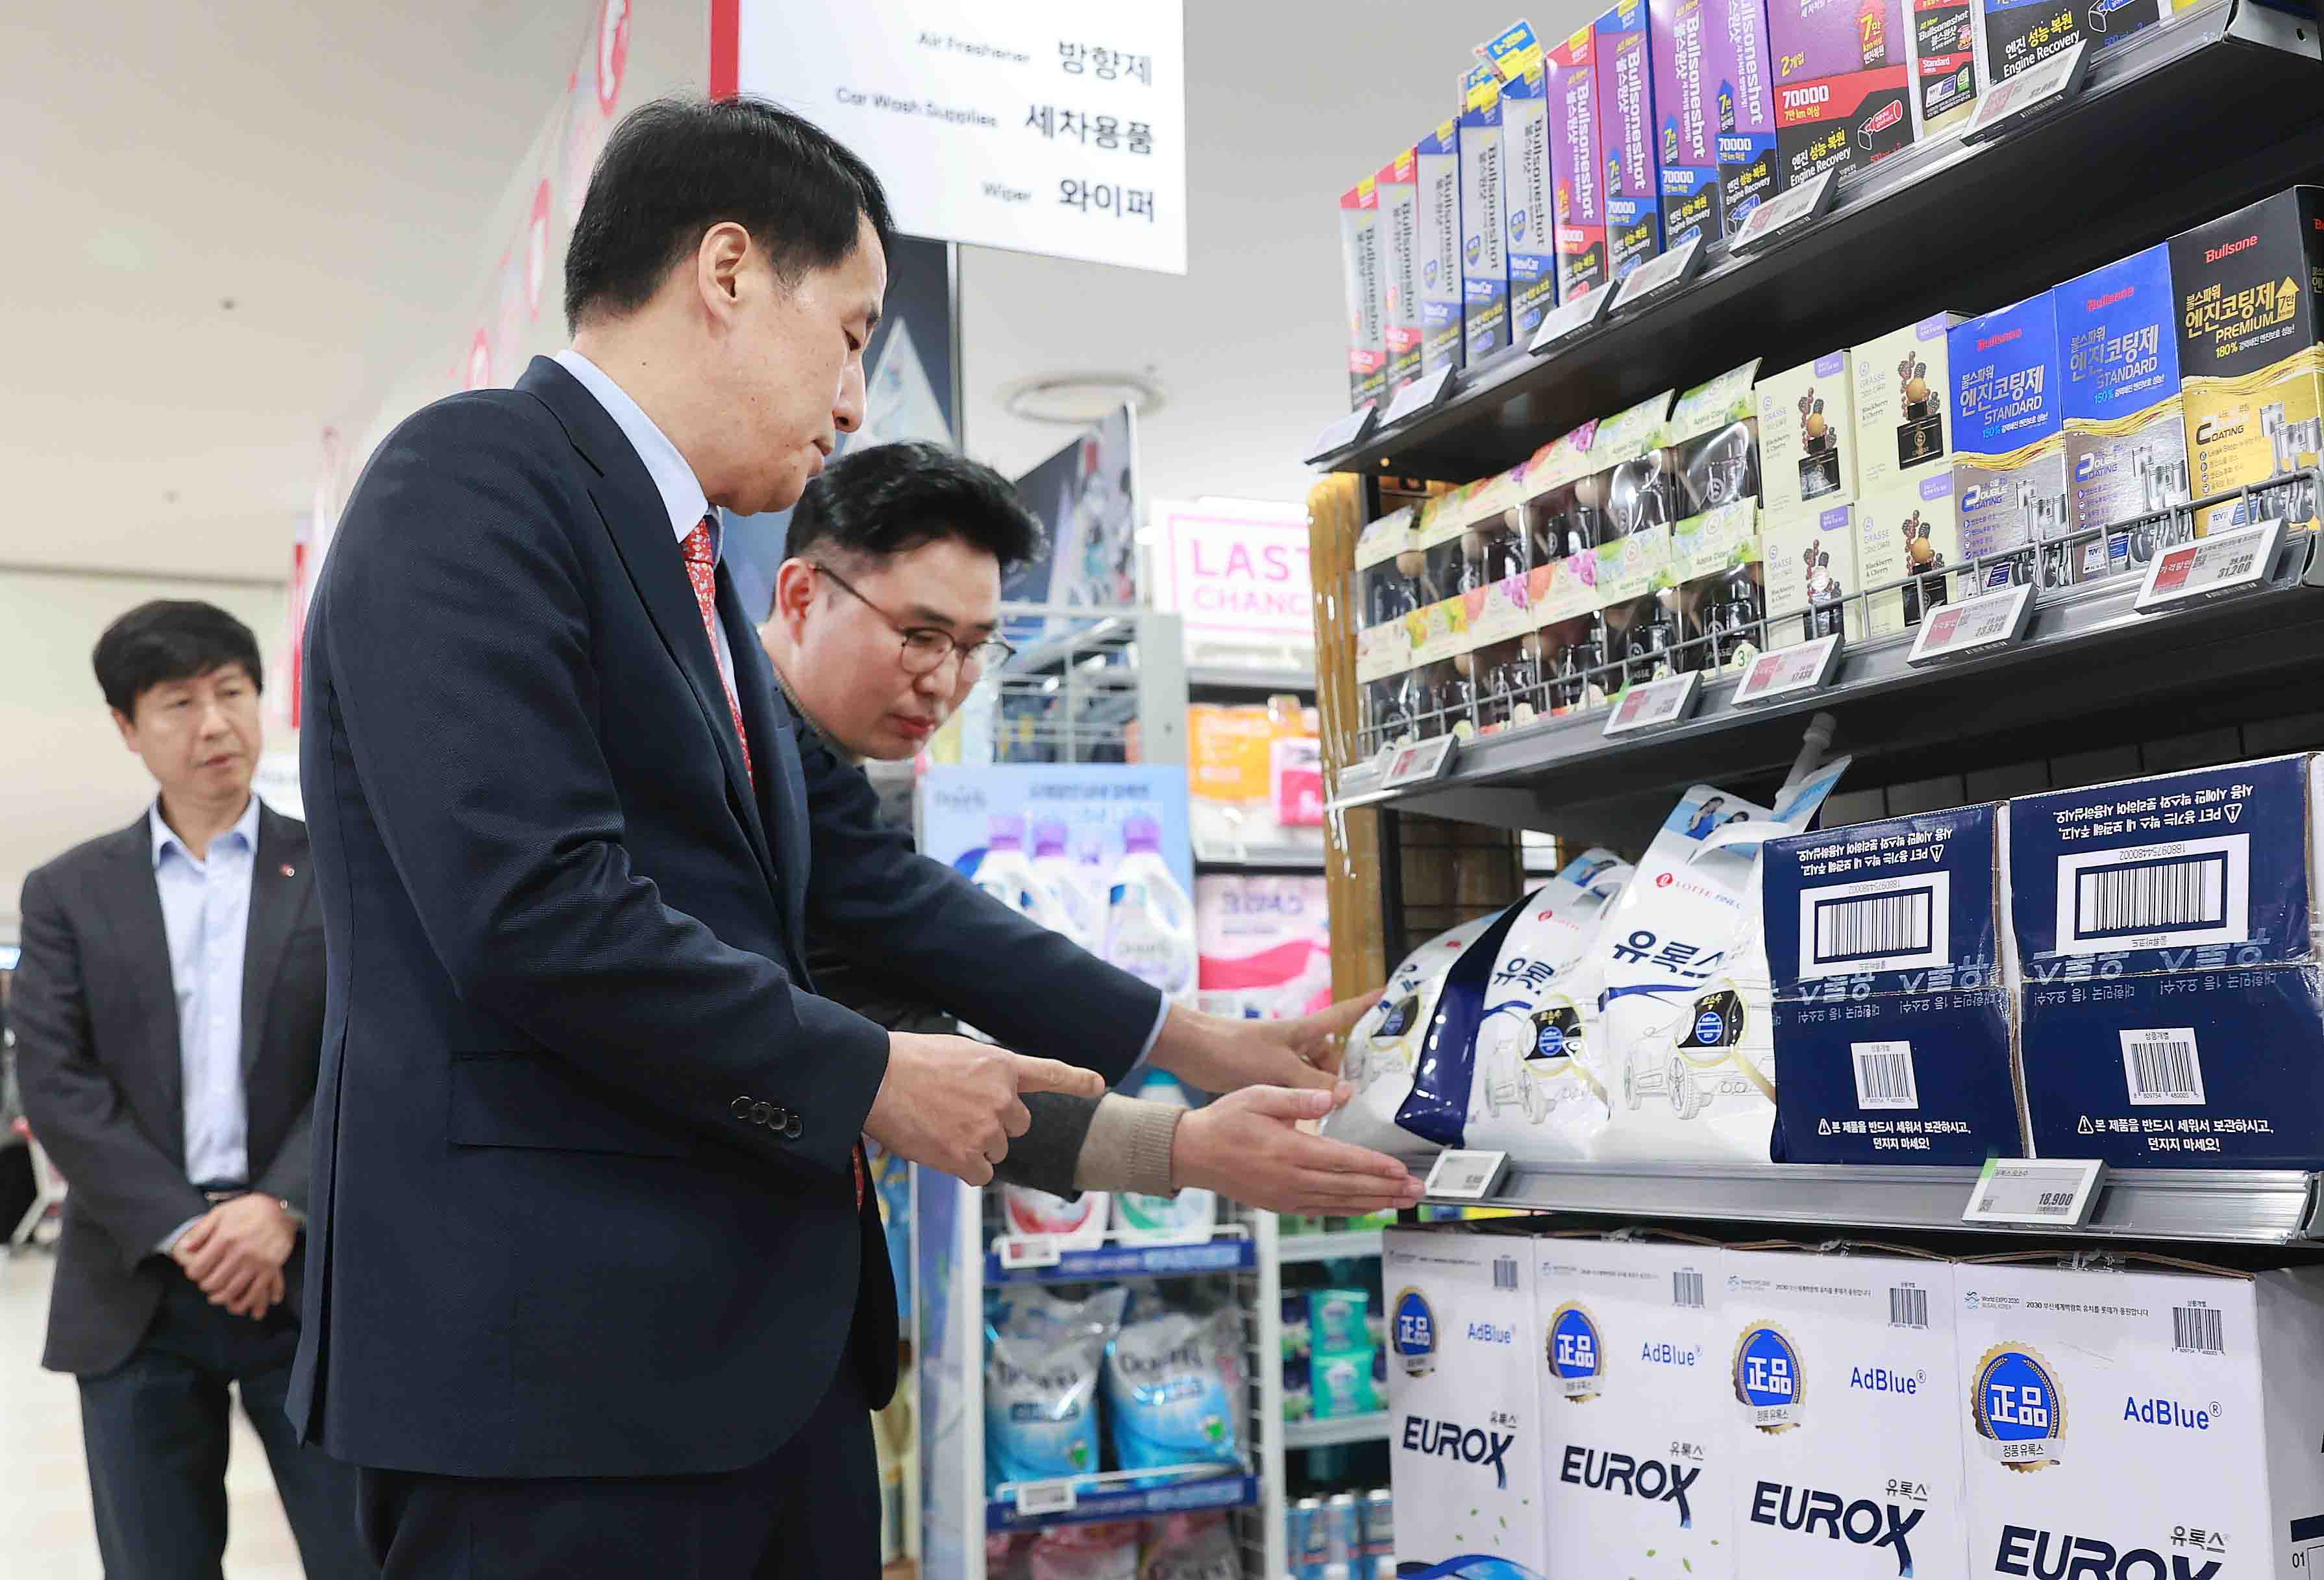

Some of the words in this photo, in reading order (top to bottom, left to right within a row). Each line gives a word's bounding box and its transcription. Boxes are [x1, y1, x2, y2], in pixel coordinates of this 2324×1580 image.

[1860, 12, 1881, 41] 7만
[1918, 10, 1969, 42] Bullsoneshot
[2005, 36, 2027, 60] 엔진
[2028, 27, 2049, 47] 성능
[2050, 10, 2073, 33] 복원
[919, 32, 942, 47] Air
[945, 35, 1030, 63] Freshener
[2003, 53, 2035, 78] Engine
[2037, 30, 2079, 61] Recovery
[1057, 40, 1152, 86] 방향제
[1740, 0, 1764, 125] ullsoneshot
[1781, 52, 1805, 77] 2개입
[1922, 57, 1950, 68] Standard
[1686, 10, 1706, 160] Bullsoneshot
[1783, 85, 1829, 108] 70000
[835, 87, 867, 106] Car
[872, 92, 920, 114] Wash
[925, 101, 998, 128] Supplies
[1785, 110, 1796, 121] 7만
[1796, 109, 1806, 119] km
[1807, 105, 1820, 117] 이상
[1627, 46, 1646, 191] Bullsoneshot
[1025, 103, 1154, 155] 세차용품
[1575, 81, 1594, 219] Bullsoneshot
[1719, 138, 1751, 151] 70000
[1792, 149, 1809, 171] 엔진
[1810, 142, 1827, 160] 성능
[1827, 129, 1846, 149] 복원
[1790, 166, 1816, 187] Engine
[1816, 146, 1851, 173] Recovery
[1533, 117, 1546, 248] Bullsoneshot
[1663, 170, 1694, 184] 70000
[982, 182, 1032, 203] Wiper
[1725, 189, 1744, 205] Engine
[1744, 176, 1771, 195] Recovery
[1059, 179, 1156, 222] 와이퍼
[1487, 146, 1500, 271] Bullsoneshot
[2204, 235, 2258, 264] Bullsone
[2186, 283, 2221, 312] 불스파워
[2279, 295, 2294, 310] 7만
[2185, 280, 2275, 339] 엔진코팅제
[2216, 312, 2274, 343] PREMIUM
[2071, 325, 2106, 353] 불스파워
[2216, 341, 2238, 358] 180%
[2281, 324, 2295, 336] 성능!
[2070, 324, 2159, 382] 엔진코팅제
[1962, 364, 1994, 389] 불스파워
[2097, 356, 2157, 389] STANDARD
[1960, 364, 2044, 417] 엔진코팅제
[2094, 389, 2114, 405] 150%
[1862, 400, 1888, 413] Blackberry
[1984, 395, 2042, 426] STANDARD
[1866, 410, 1883, 421] Cherry
[1983, 425, 2001, 438] 150%
[2197, 423, 2244, 445] COATING
[1866, 558, 1892, 570] Blackberry
[2160, 560, 2192, 573] 가격할인
[2218, 562, 2251, 578] 31,200
[1194, 587, 1312, 615] CHANC
[2195, 789, 2228, 804] 시에만
[2231, 784, 2253, 799] 사용
[2117, 798, 2157, 815] 분리하여
[2160, 793, 2191, 809] 박스와
[2053, 804, 2114, 824] 사용하십시오.
[2140, 815, 2160, 829] 박스
[2164, 811, 2195, 826] 용기는
[2199, 808, 2221, 822] PET
[2058, 824, 2090, 840] 주시고,
[2094, 821, 2122, 836] 보관해
[2127, 819, 2136, 832] 내
[1881, 835, 1905, 850] 박스와
[1907, 832, 1932, 845] 시에만
[1935, 828, 1953, 841] 사용
[1796, 844, 1844, 861] 사용하십시오.
[1847, 839, 1878, 854] 분리하여
[1910, 848, 1927, 861] PET
[2120, 843, 2186, 860] 18809754480002
[1828, 860, 1851, 872] 보관해
[1854, 857, 1862, 869] 내
[1864, 854, 1881, 866] 박스
[1884, 852, 1908, 864] 용기는
[1801, 863, 1826, 876] 주시고,
[1613, 931, 1724, 979] 유록스
[2159, 929, 2271, 972] 유록스
[1493, 958, 1554, 994] 유록
[2033, 951, 2129, 985] 유록스
[2160, 979, 2197, 995] 요소수!
[2205, 976, 2221, 990] 1등
[2227, 971, 2276, 988] 대한민국
[1799, 972, 1875, 1005] 유록스
[2072, 988, 2086, 1002] 1등
[2092, 985, 2135, 1001] 대한민국
[1900, 998, 1929, 1014] 요소수!
[1935, 996, 1947, 1010] 1등
[1953, 992, 1996, 1008] 대한민국
[2034, 991, 2066, 1006] 요소수!
[1798, 1011, 1825, 1024] 요소수!
[1829, 1008, 1841, 1020] 1등
[1846, 1005, 1880, 1020] 대한민국
[2145, 1031, 2169, 1041] 상품개별
[1832, 1121, 1840, 1133] 본
[1842, 1121, 1867, 1133] 제품을
[1868, 1121, 1894, 1133] 반드시
[1896, 1121, 1922, 1133] 세워서
[1924, 1121, 1971, 1134] 보관하시고,
[2095, 1119, 2106, 1132] 본
[2108, 1118, 2140, 1132] 제품을
[2142, 1118, 2174, 1133] 반드시
[2177, 1118, 2209, 1133] 세워서
[2214, 1119, 2274, 1133] 보관하시고,
[1873, 1137, 1899, 1150] 던지지
[1901, 1137, 1930, 1150] 마세요!
[2148, 1138, 2180, 1152] 던지지
[2183, 1138, 2221, 1152] 마세요!
[2026, 1301, 2042, 1309] 2030
[2101, 1306, 2118, 1315] 롯데가
[2120, 1308, 2149, 1317] 응원합니다
[1401, 1315, 1430, 1346] 正品
[1557, 1334, 1595, 1368] 正品
[1747, 1356, 1792, 1395] 正品
[1990, 1383, 2048, 1427] 正品
[1490, 1411, 1517, 1429] 유록스
[1403, 1415, 1515, 1489] EUROX
[1669, 1442, 1704, 1461] 유록스
[2020, 1442, 2044, 1457] 유록스
[1561, 1445, 1701, 1528] EUROX
[1885, 1479, 1928, 1502] 유록스
[1750, 1480, 1925, 1579] EUROX
[2171, 1525, 2227, 1553] 유록스
[2292, 1551, 2305, 1568] 01
